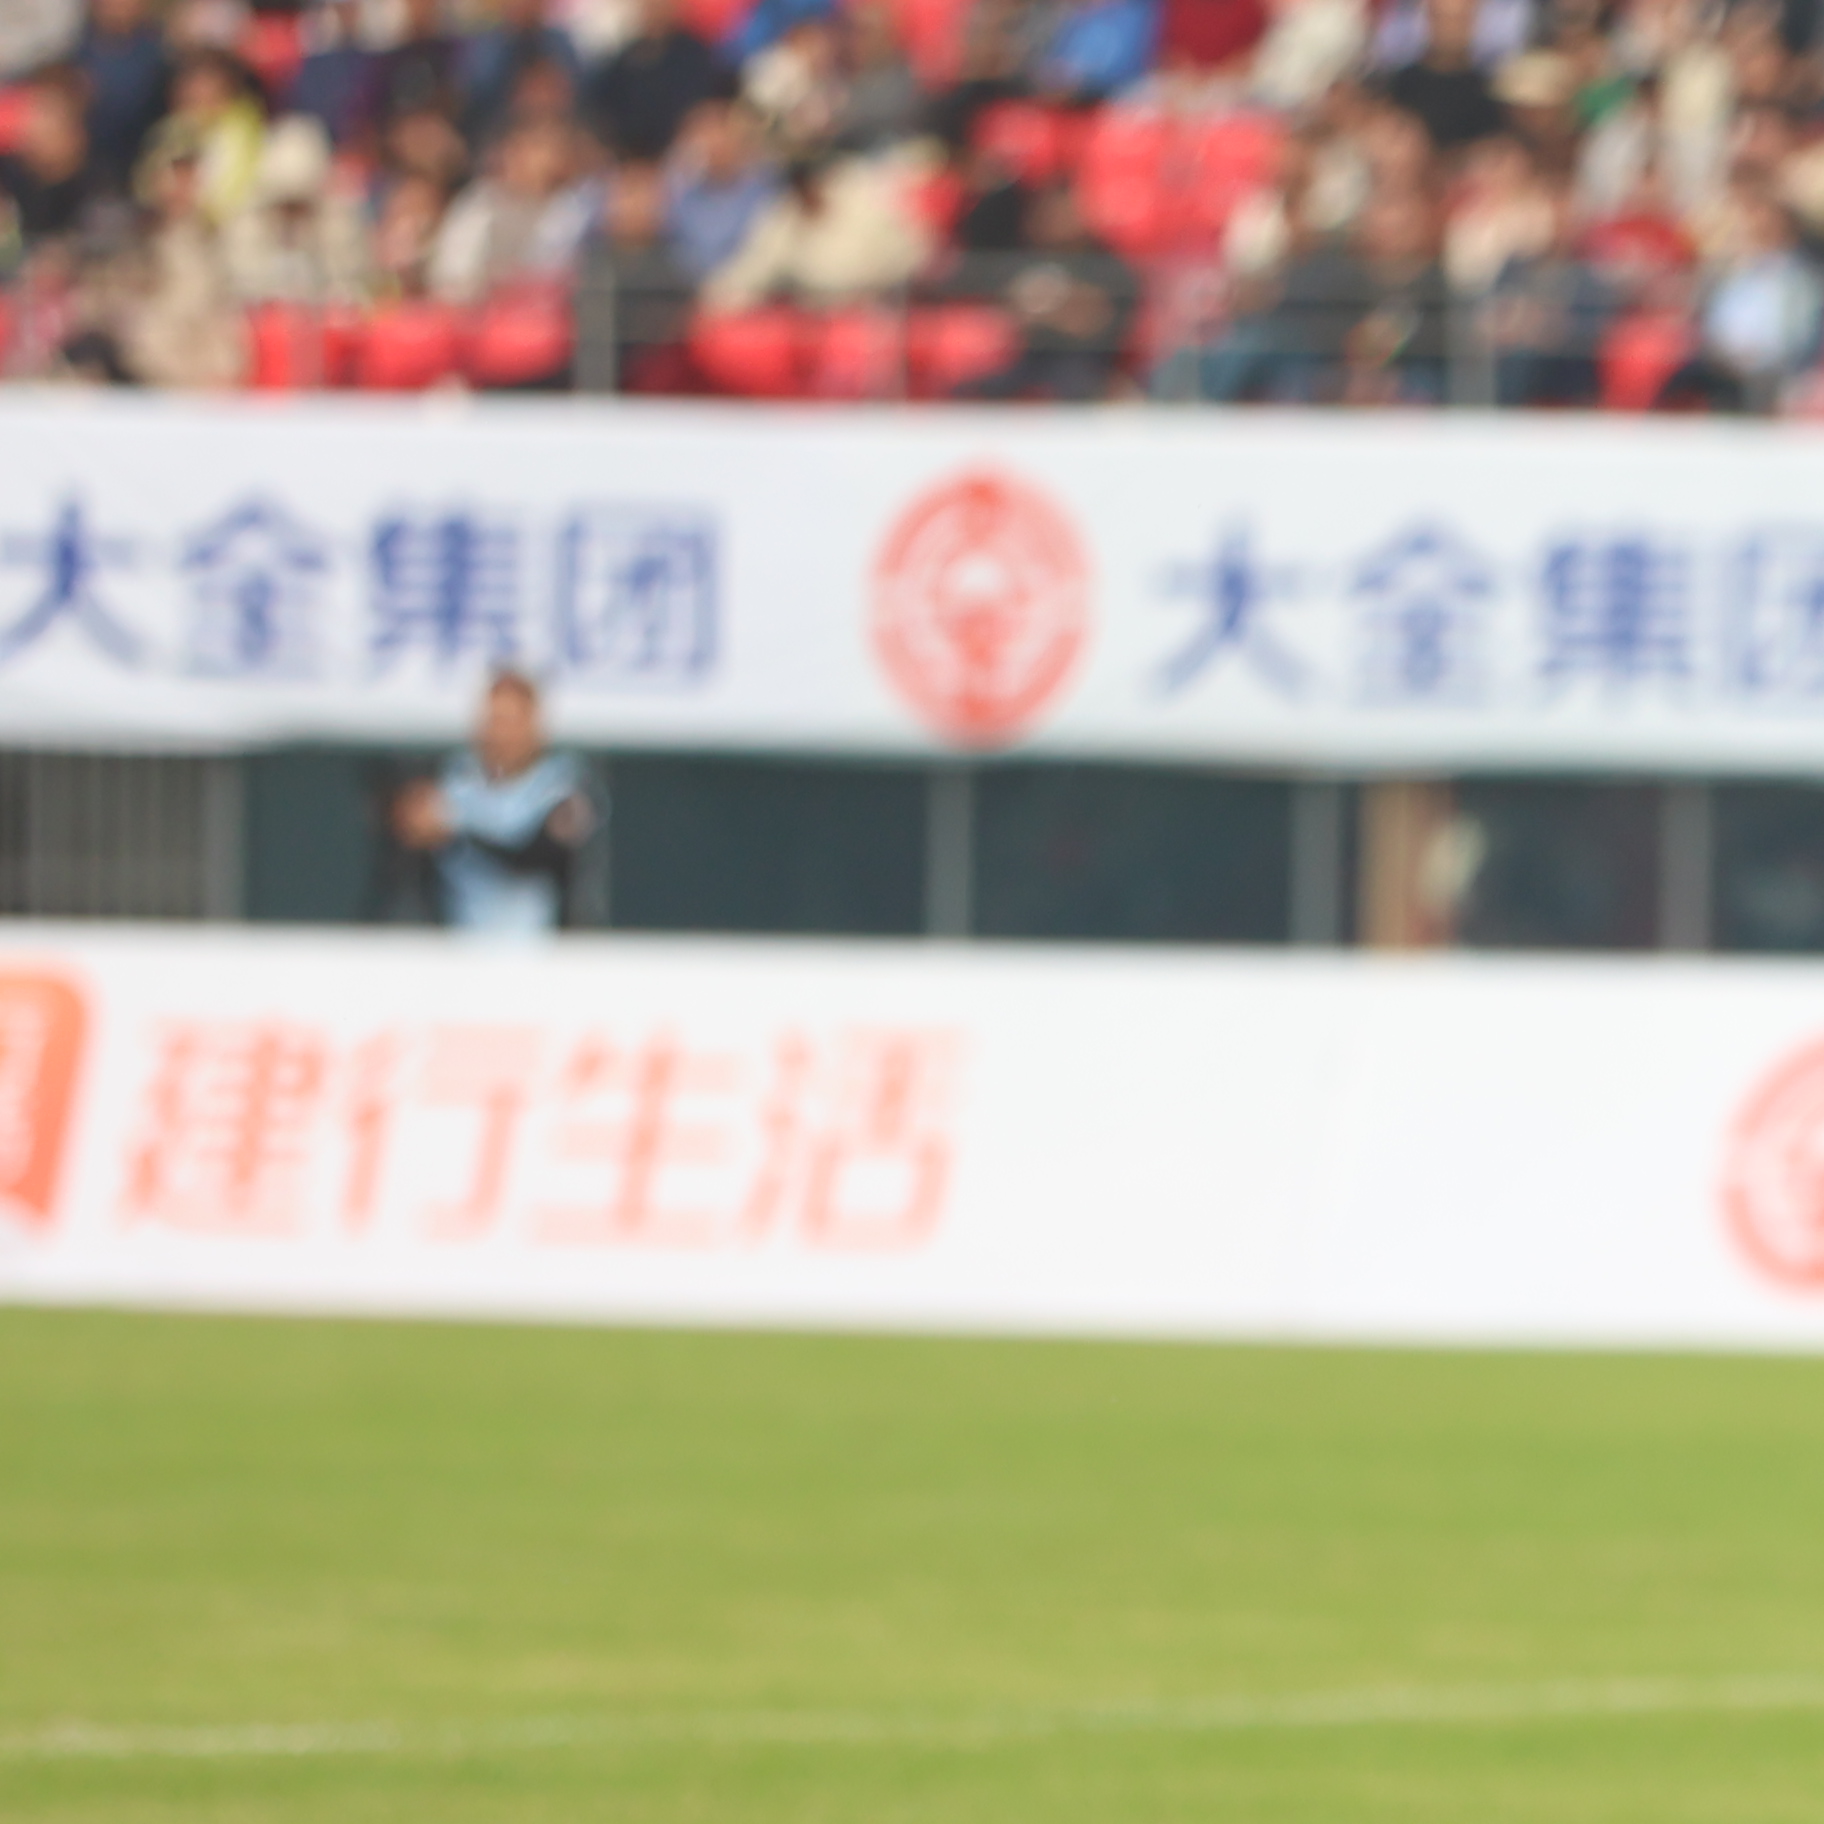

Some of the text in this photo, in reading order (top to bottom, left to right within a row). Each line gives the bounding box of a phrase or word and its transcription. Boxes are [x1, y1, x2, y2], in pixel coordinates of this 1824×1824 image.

[0, 488, 728, 692] 大全集团
[115, 1015, 970, 1252] 建行生活
